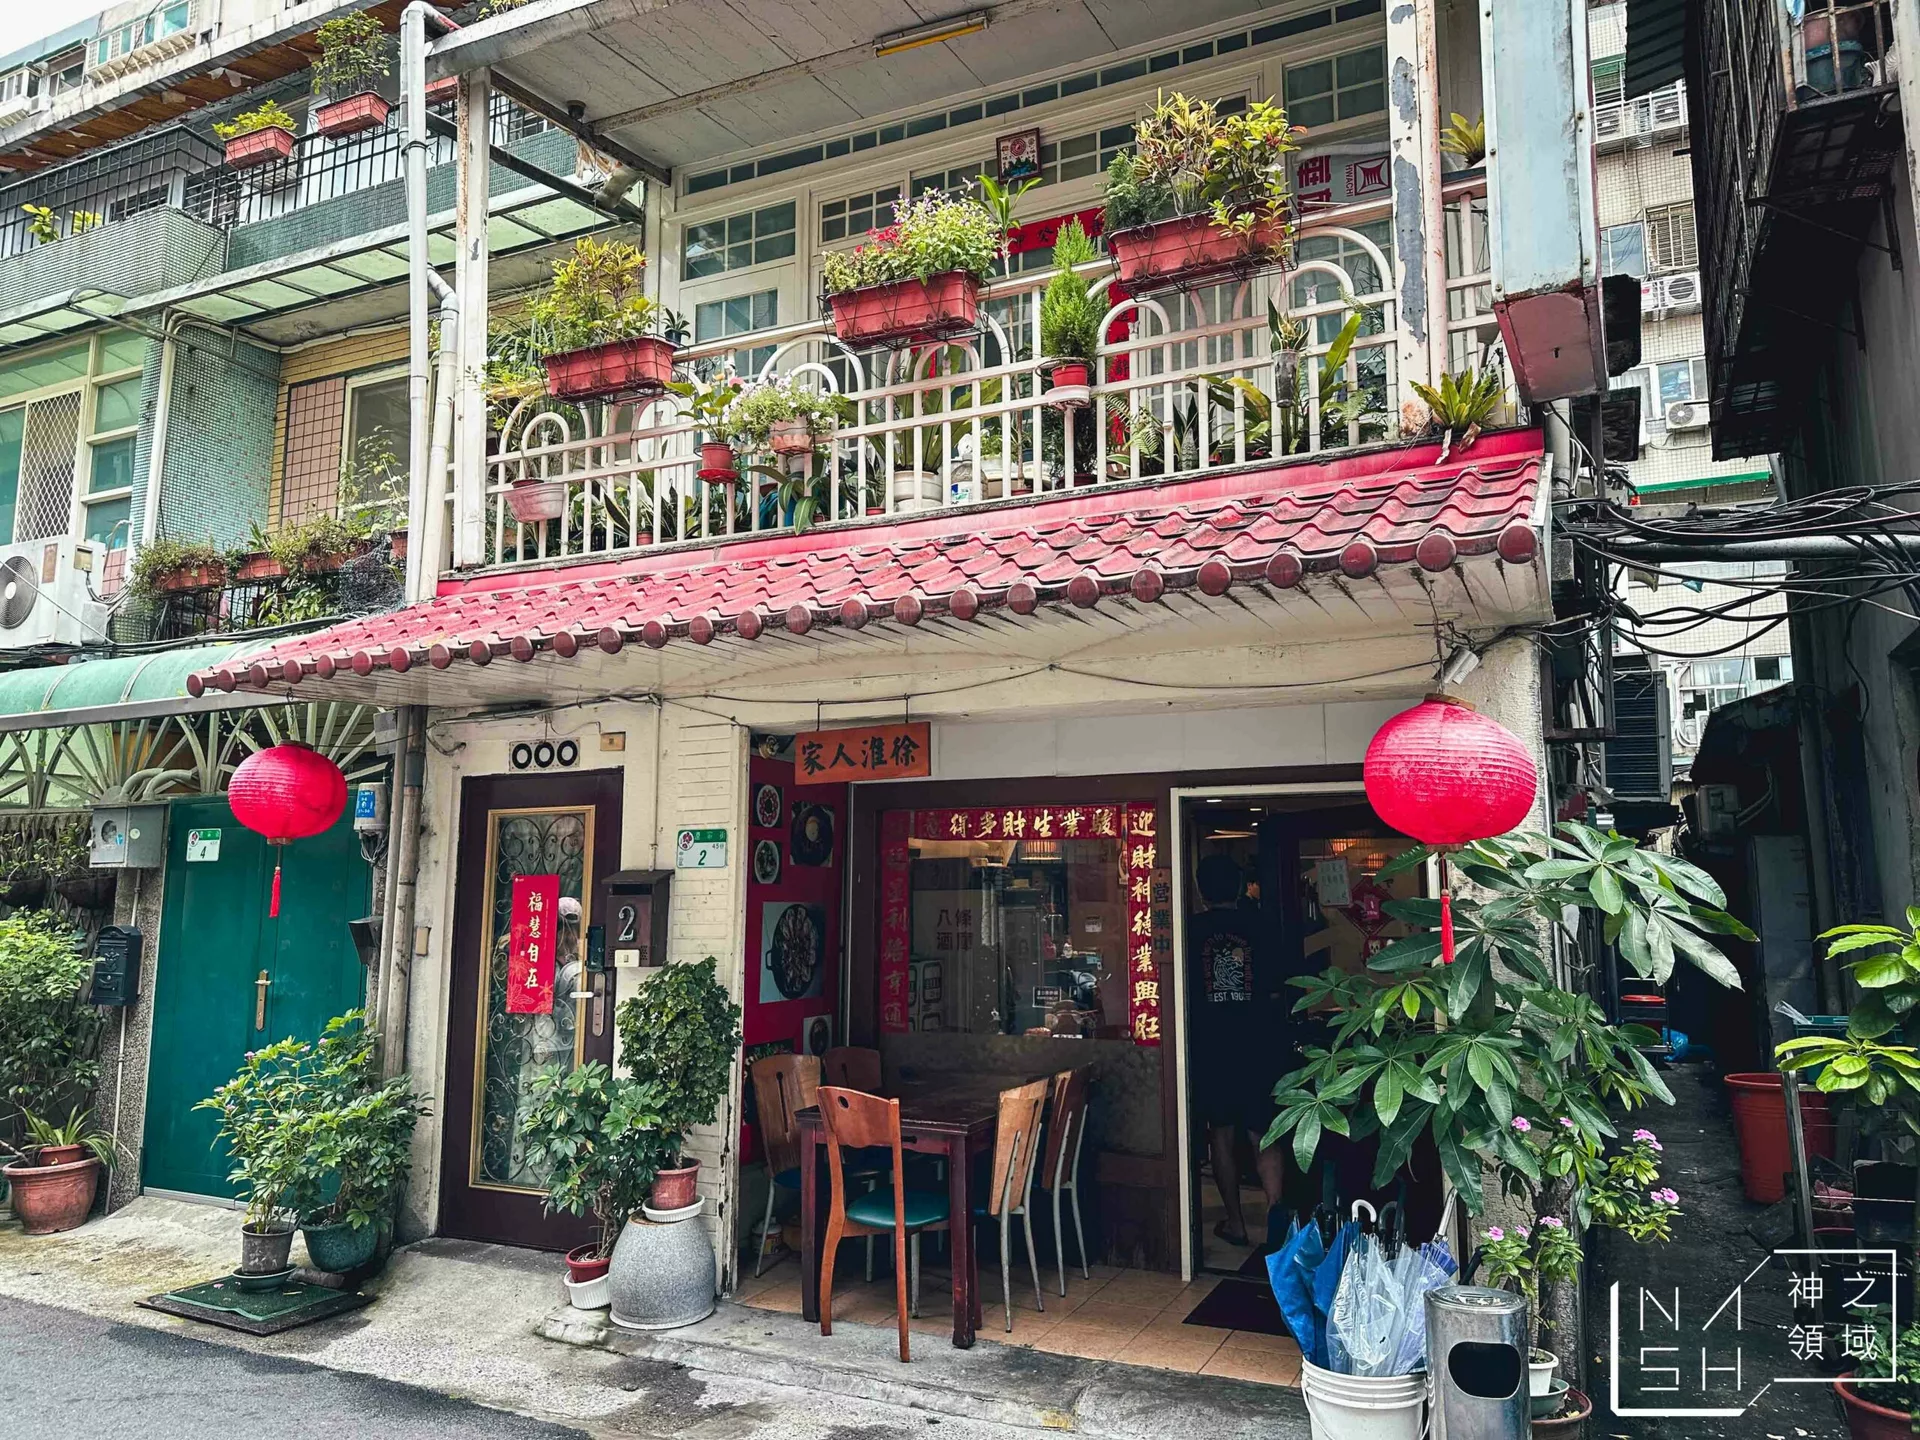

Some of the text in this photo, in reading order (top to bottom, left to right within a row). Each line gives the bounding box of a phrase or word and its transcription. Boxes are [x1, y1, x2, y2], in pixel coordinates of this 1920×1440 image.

[1345, 164, 1354, 197] HWACHI
[801, 735, 921, 775] 徐淮人家
[200, 846, 207, 859] 4
[698, 849, 707, 866] 2
[524, 891, 544, 989] 福慧自在
[618, 905, 635, 942] 2
